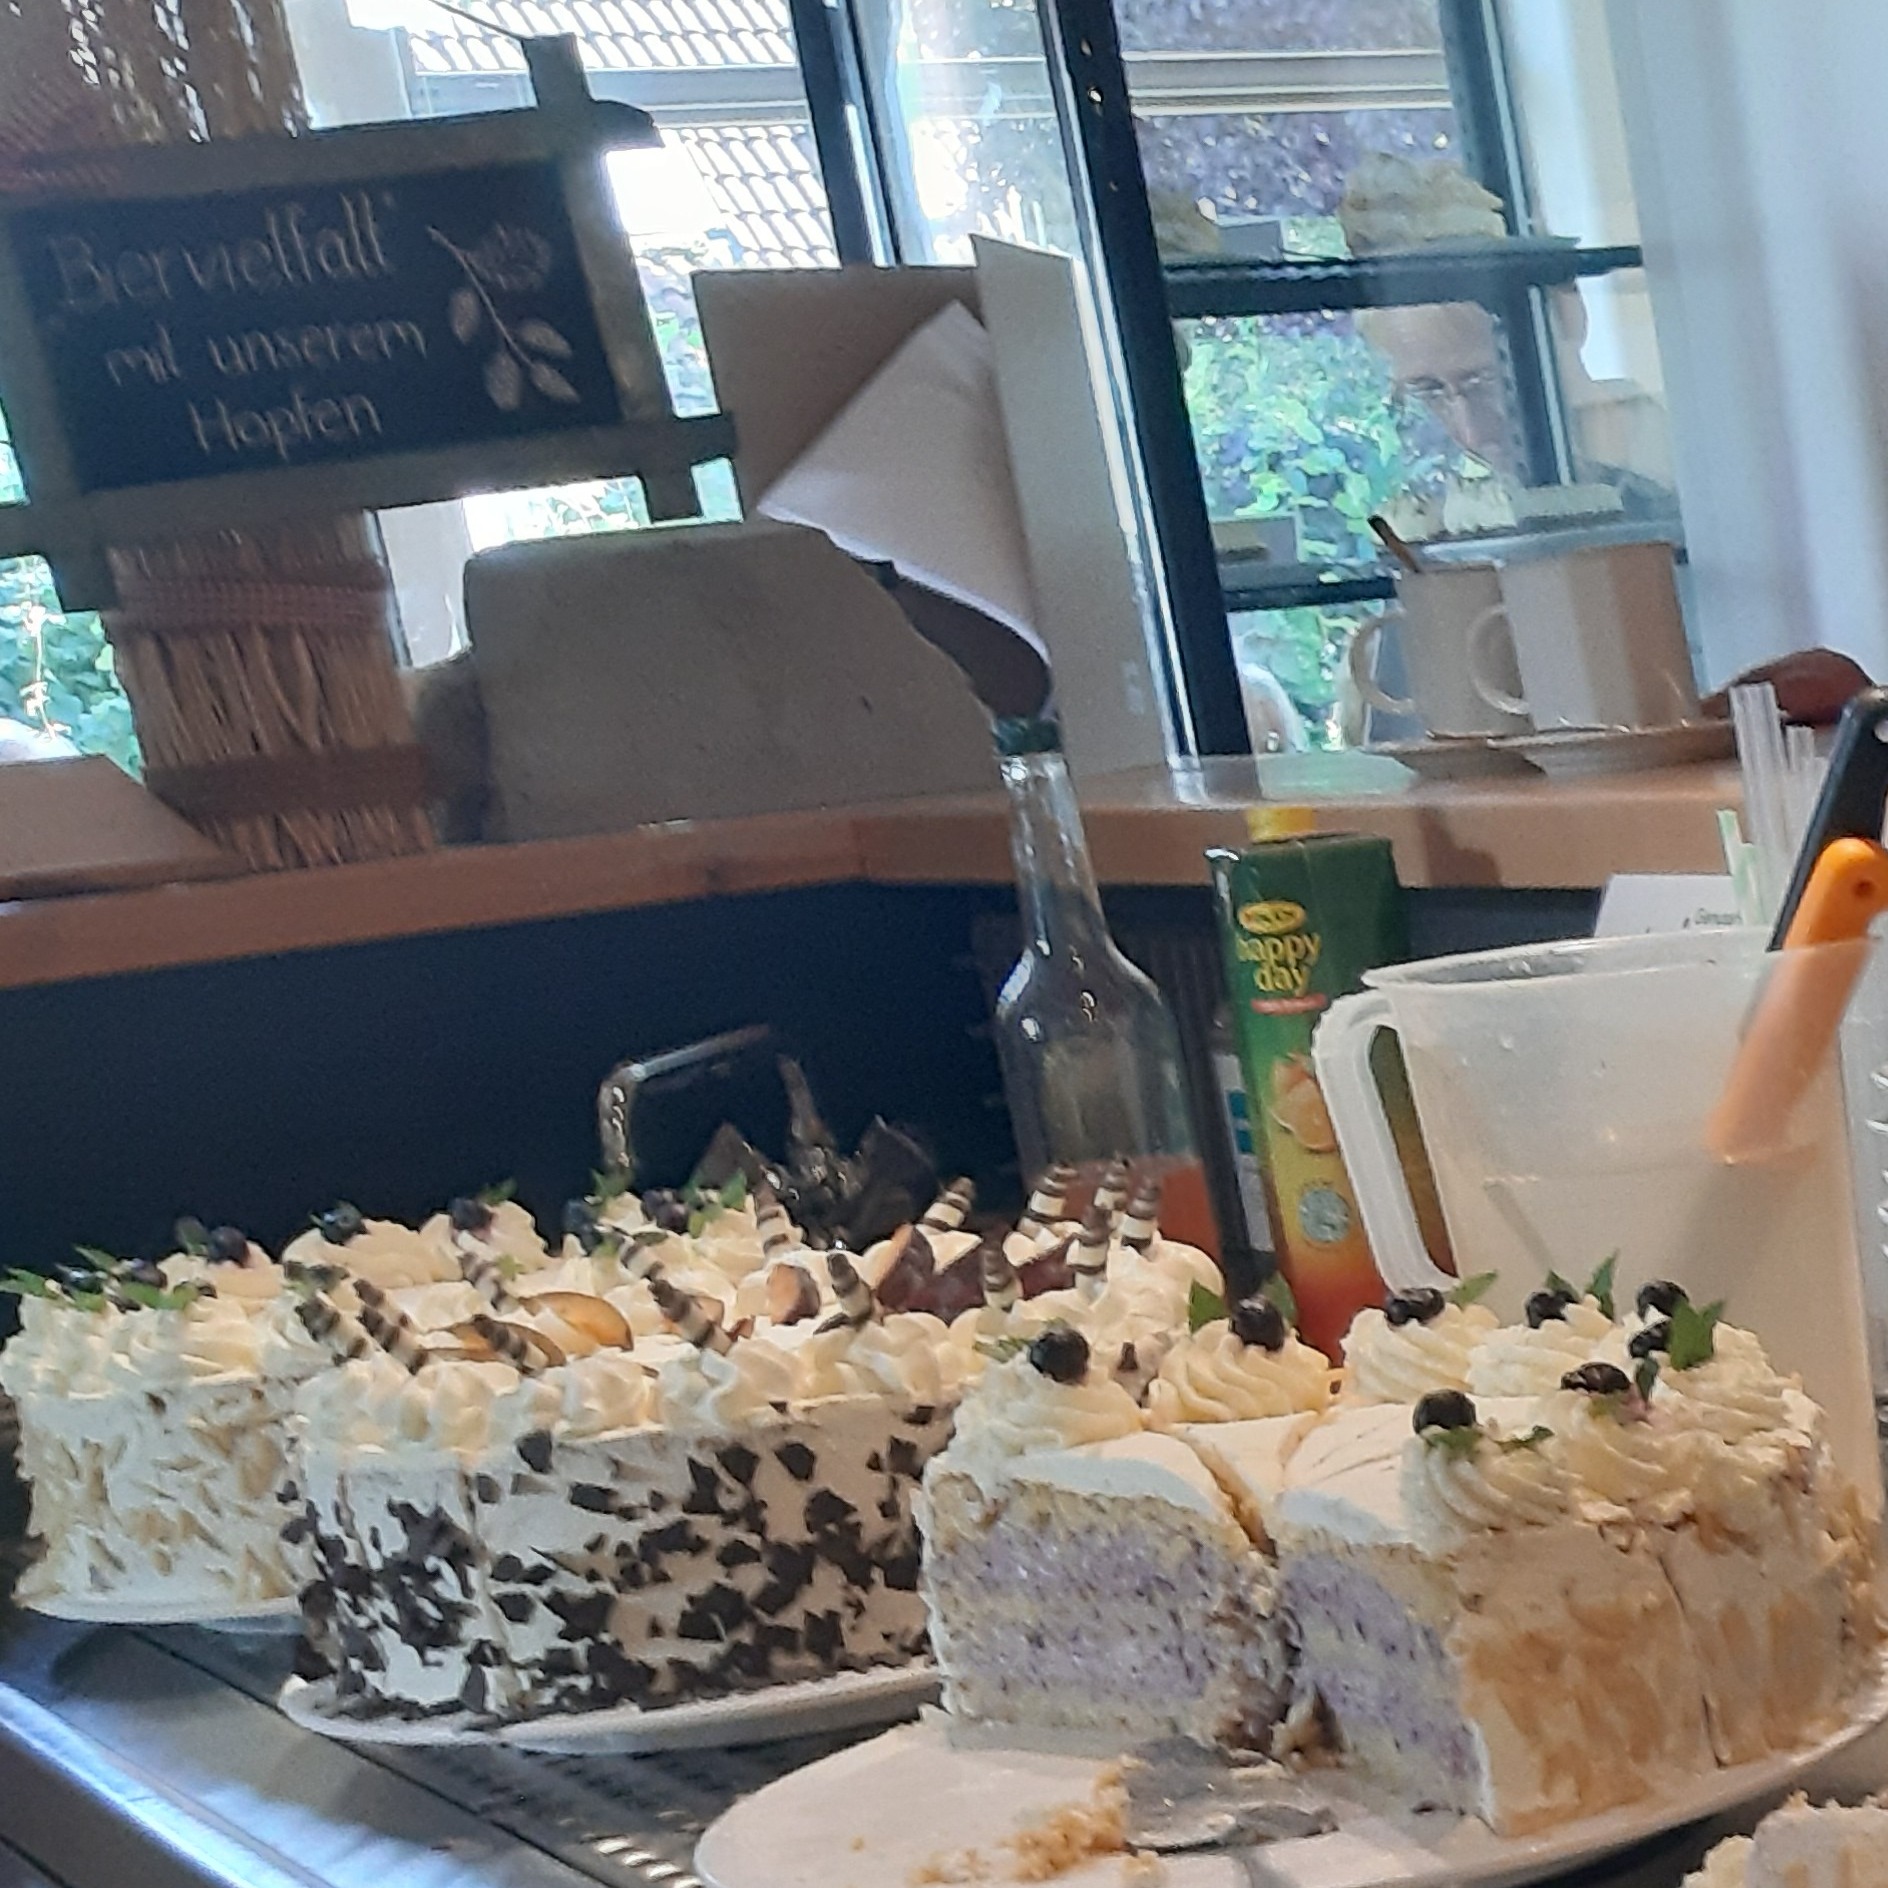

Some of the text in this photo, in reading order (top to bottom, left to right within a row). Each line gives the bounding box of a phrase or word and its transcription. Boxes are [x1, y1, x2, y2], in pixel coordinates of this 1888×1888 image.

[207, 319, 427, 376] unserem
[186, 388, 383, 463] Hopfen
[1235, 932, 1322, 968] happy
[1253, 963, 1309, 997] day
